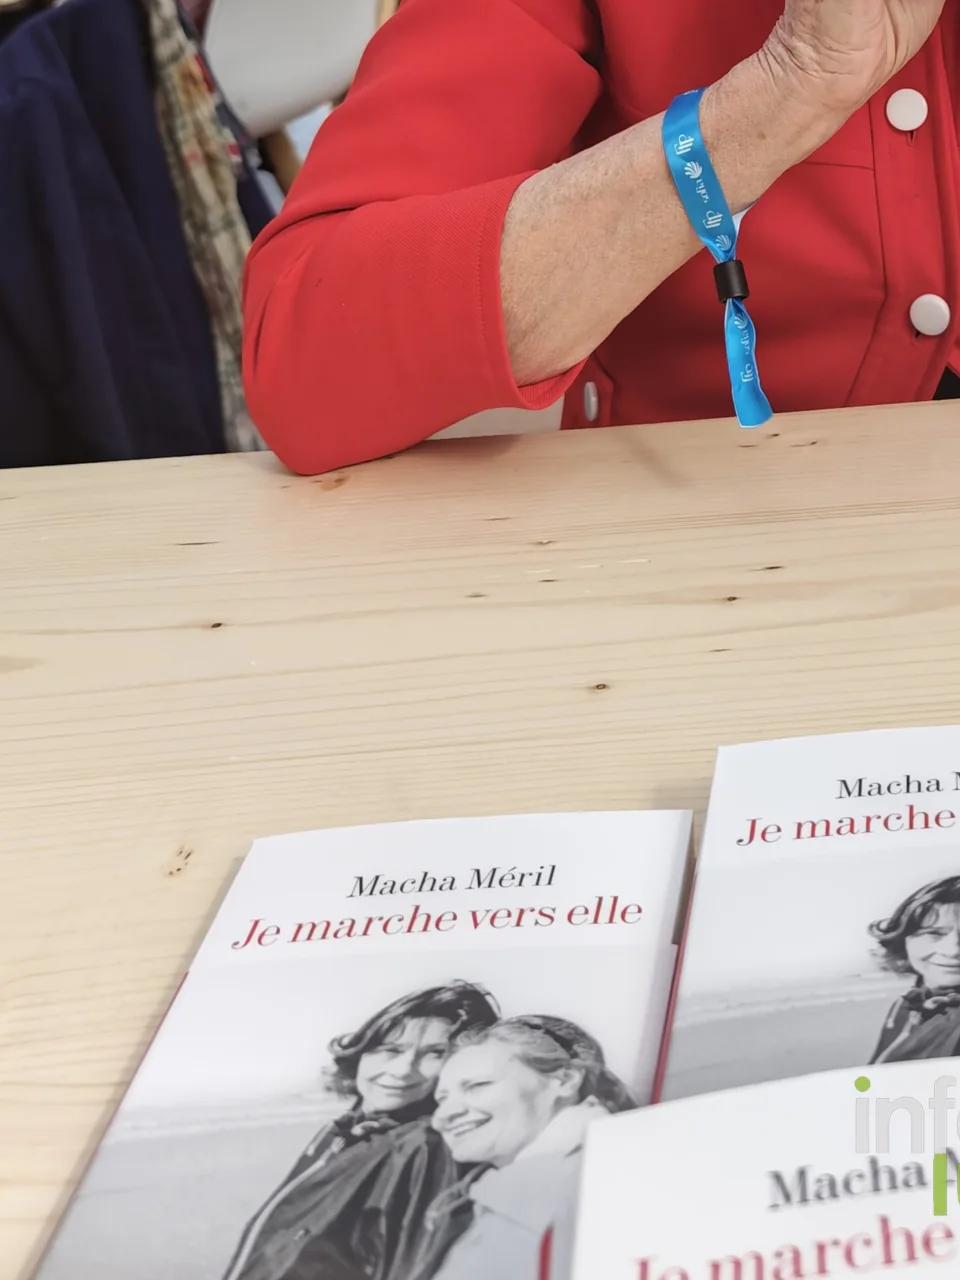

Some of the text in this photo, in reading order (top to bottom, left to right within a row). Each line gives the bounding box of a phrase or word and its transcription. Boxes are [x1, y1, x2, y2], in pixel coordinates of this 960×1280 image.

[835, 775, 945, 800] Macha
[735, 817, 784, 848] Je
[794, 804, 957, 841] marche
[346, 864, 557, 899] Macha Méril
[231, 895, 644, 951] Je marche vers elle
[767, 1155, 929, 1210] Macha
[706, 1214, 956, 1280] marche
